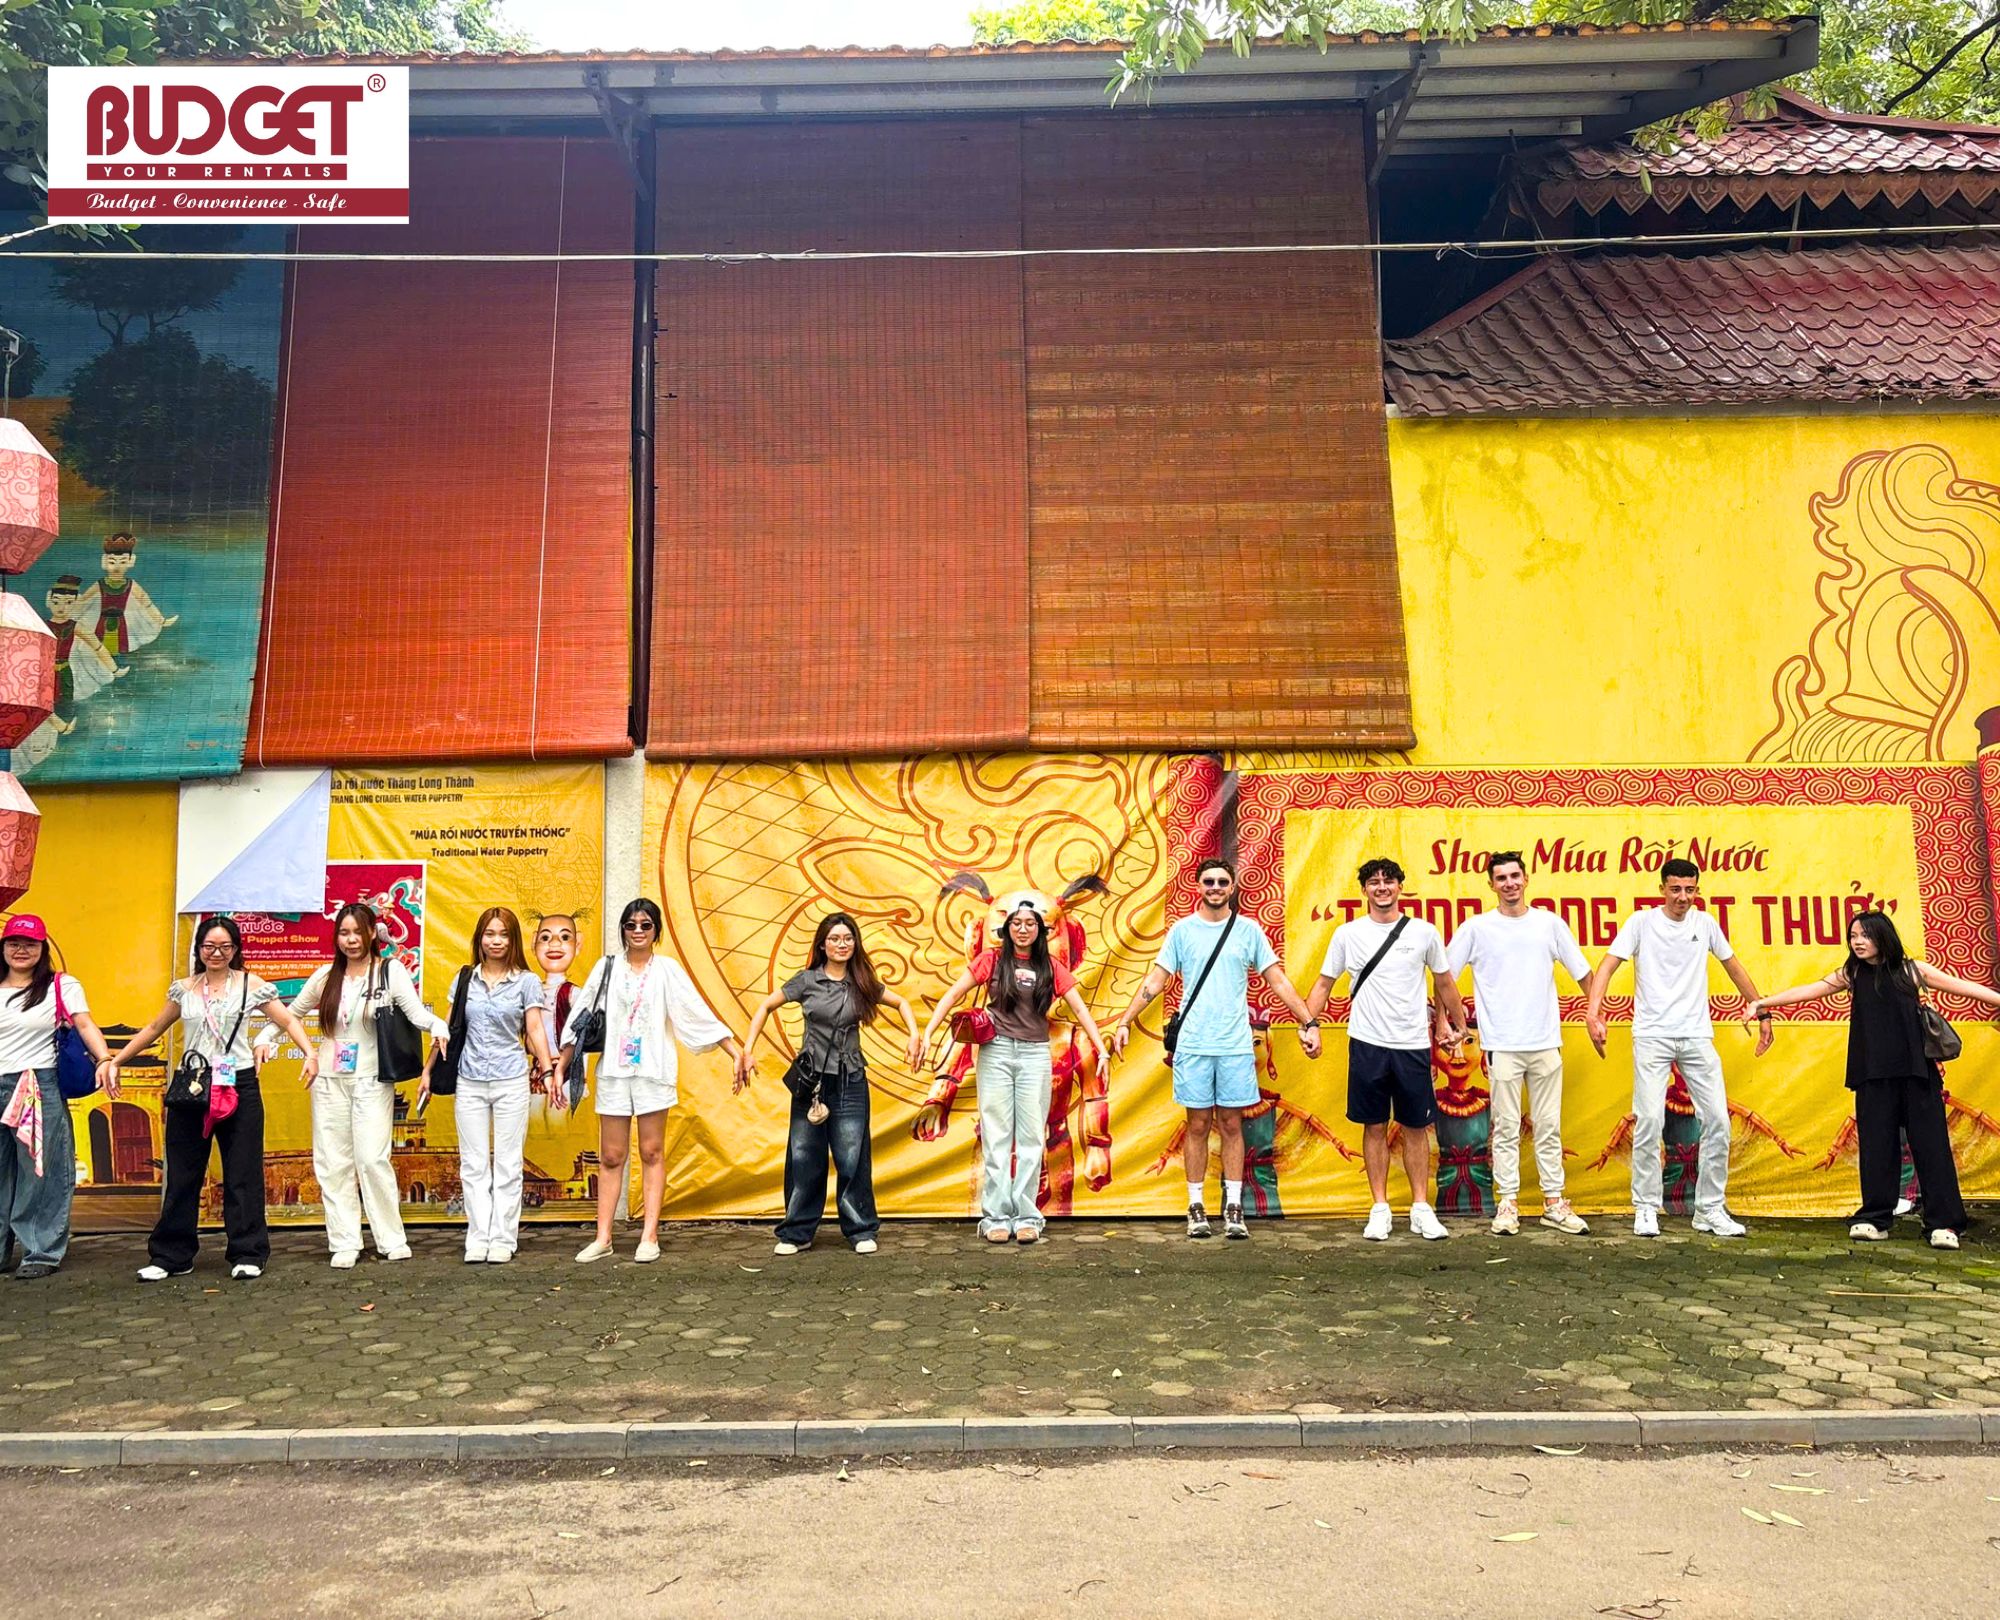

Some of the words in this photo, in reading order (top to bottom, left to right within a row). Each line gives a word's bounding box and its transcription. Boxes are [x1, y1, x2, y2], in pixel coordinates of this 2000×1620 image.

[331, 778, 342, 790] úa
[419, 777, 442, 790] Long
[428, 794, 463, 803] PUPPETRY
[432, 848, 478, 857] Traditional
[480, 848, 505, 857] Water
[507, 847, 548, 858] Puppetry
[1429, 838, 1522, 875] Sho
[1531, 837, 1608, 874] Múa
[1686, 836, 1769, 873] Nước
[1530, 897, 1618, 946] NG
[247, 935, 288, 945] Puppet
[290, 934, 319, 943] Show
